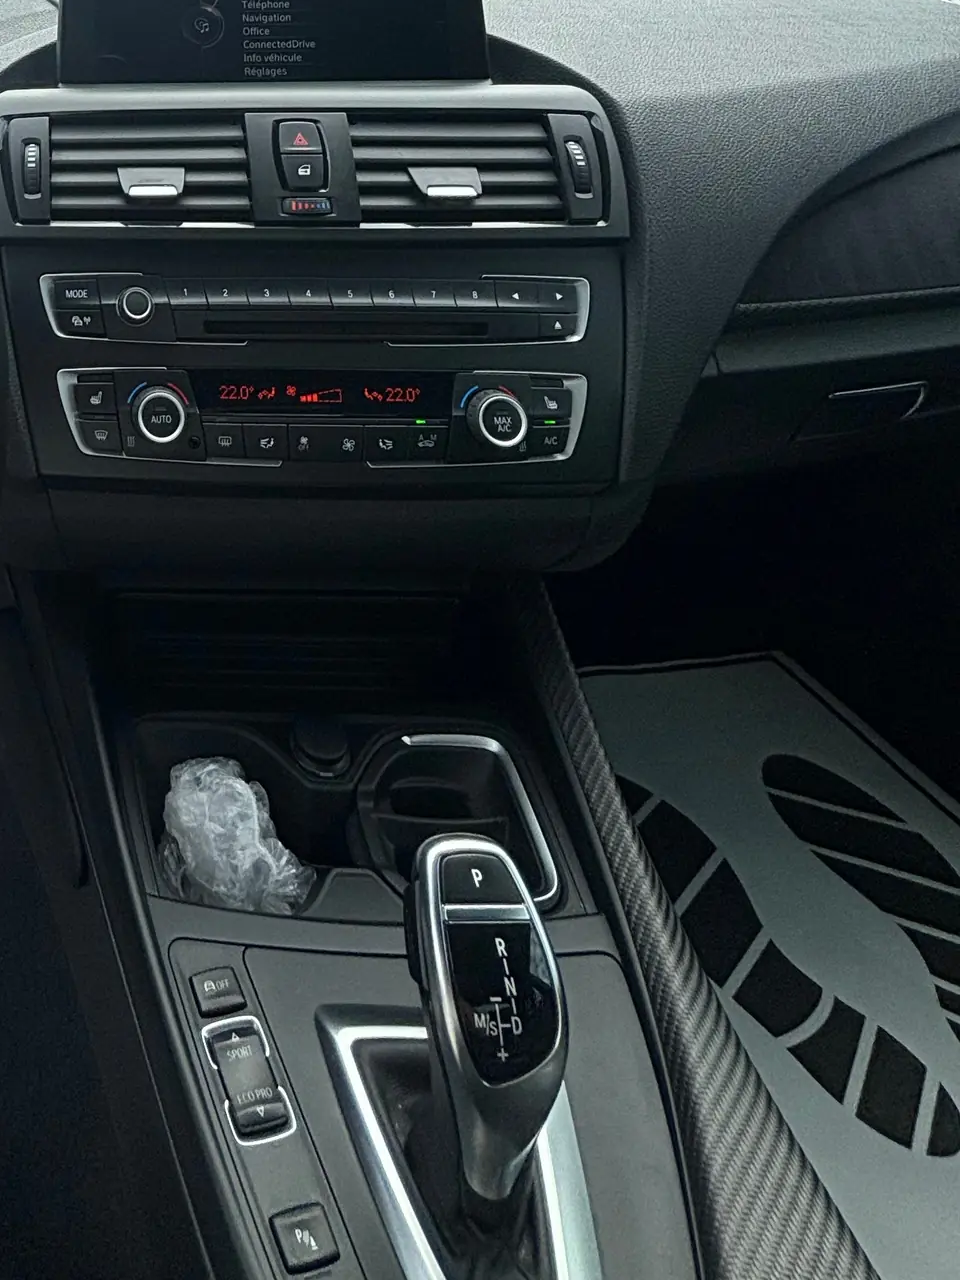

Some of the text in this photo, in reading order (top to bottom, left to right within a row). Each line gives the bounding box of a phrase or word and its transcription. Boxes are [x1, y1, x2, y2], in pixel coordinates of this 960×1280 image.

[242, 0, 290, 10] Téléphone
[243, 13, 291, 24] Navigation
[243, 27, 270, 35] Office
[243, 39, 316, 49] ConnectedDrive
[243, 53, 302, 62] Info véhicule
[244, 67, 287, 78] Réglages
[66, 289, 89, 298] MODE
[184, 288, 188, 296] 1
[222, 288, 228, 296] 2
[264, 289, 270, 297] 3
[305, 289, 311, 297] 4
[347, 290, 353, 298] 5
[388, 290, 395, 298] 6
[431, 290, 436, 298] 7
[472, 290, 478, 299] 8
[151, 415, 172, 424] AUTO
[494, 417, 512, 425] MAX
[498, 424, 512, 432] A/C
[544, 437, 558, 445] A/C
[471, 869, 483, 888] P
[495, 937, 508, 957] R
[215, 978, 230, 990] OFF
[504, 976, 517, 996] N
[511, 1016, 523, 1035] D
[227, 1045, 253, 1061] SPORT
[236, 1087, 273, 1105] ECO PRO
